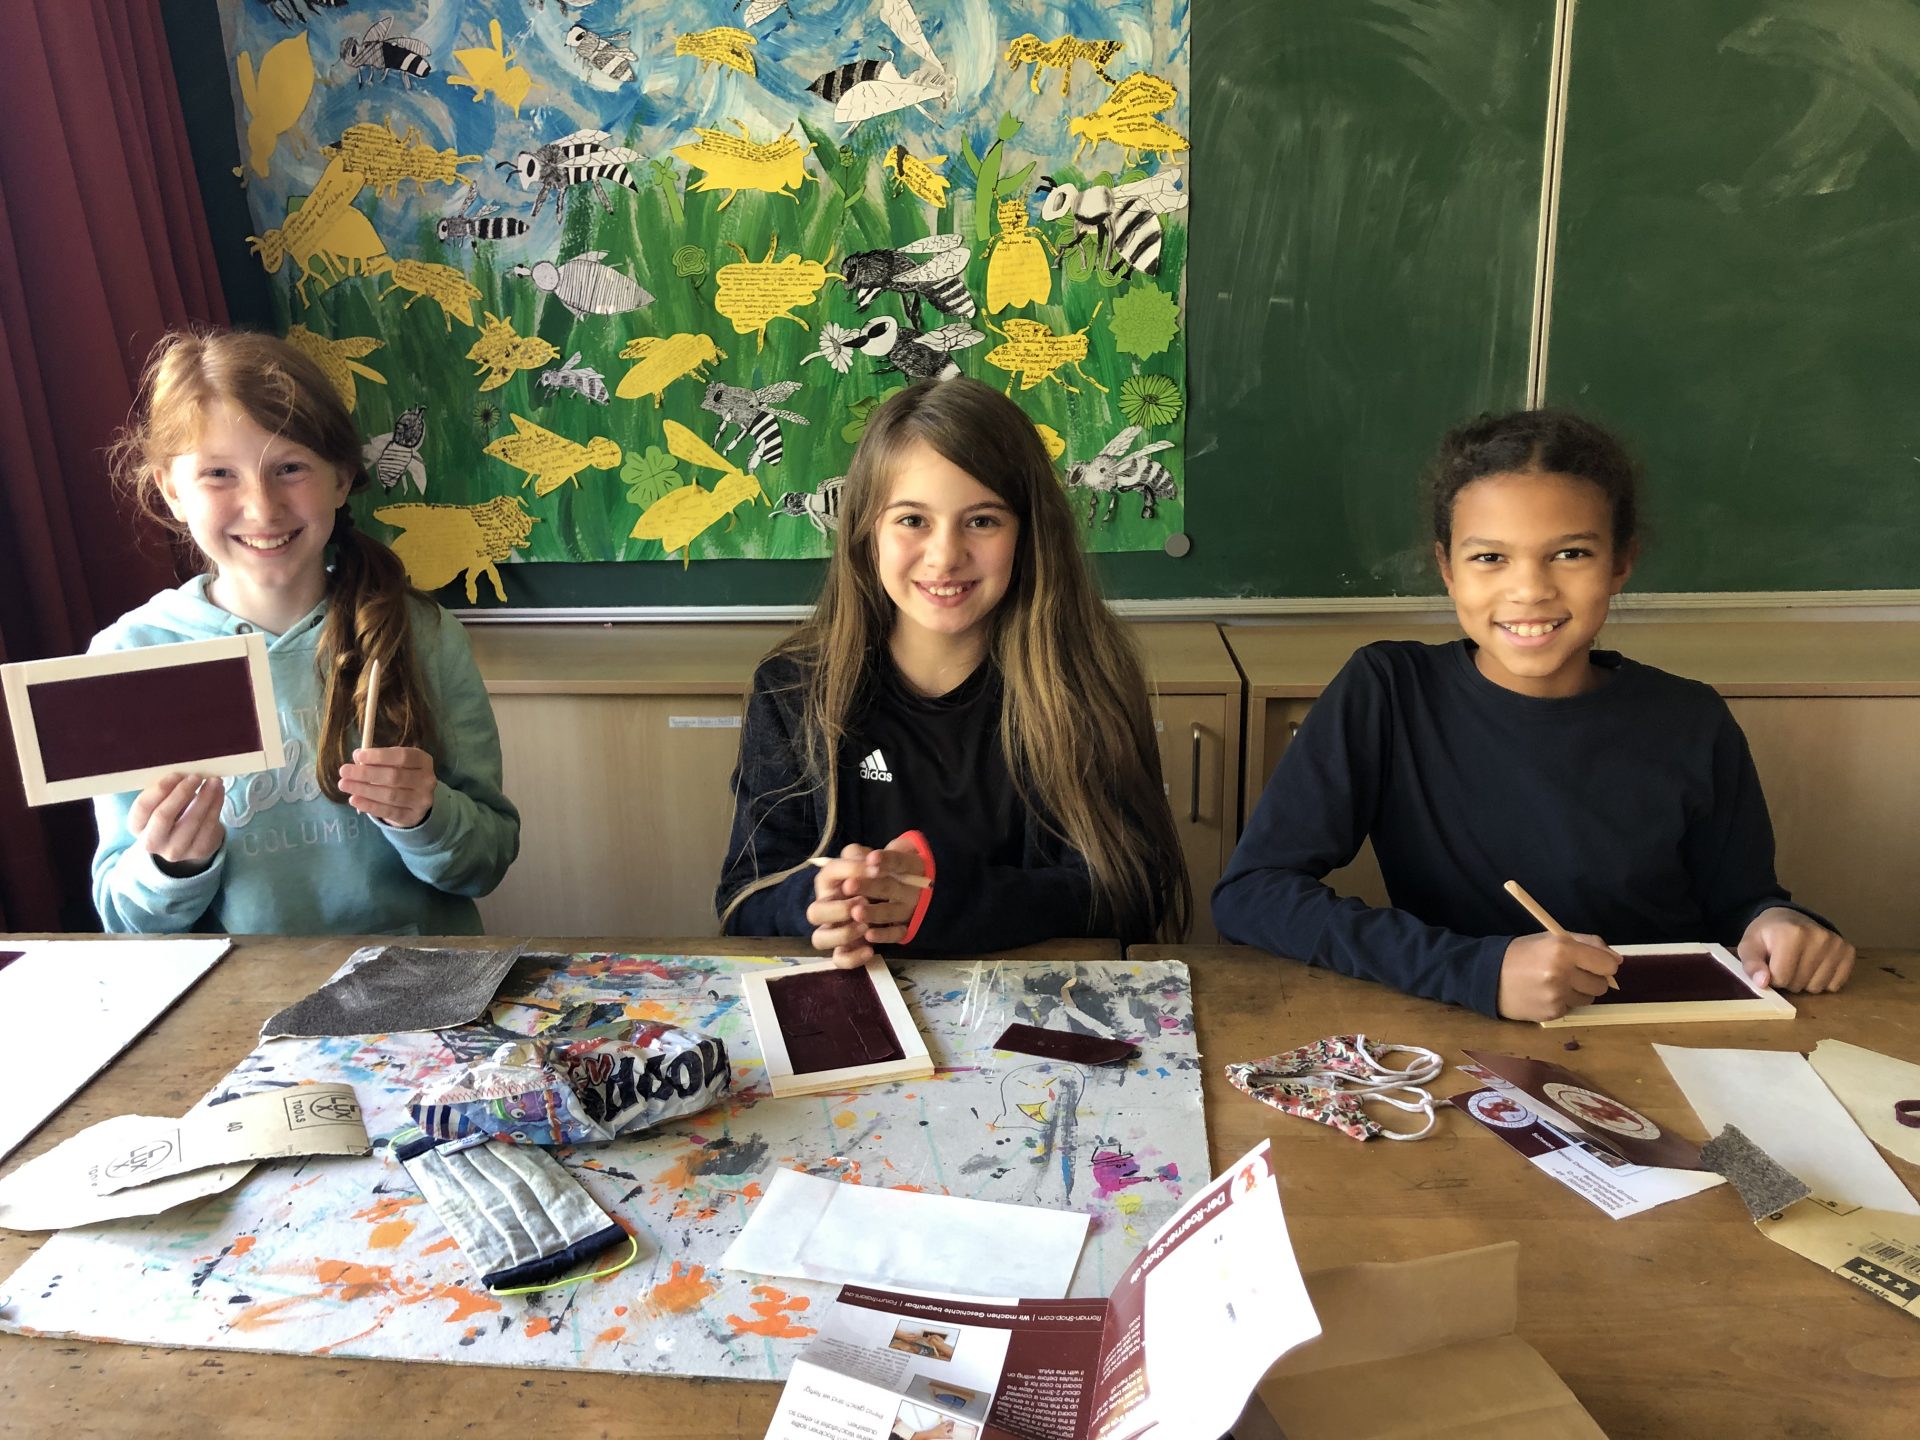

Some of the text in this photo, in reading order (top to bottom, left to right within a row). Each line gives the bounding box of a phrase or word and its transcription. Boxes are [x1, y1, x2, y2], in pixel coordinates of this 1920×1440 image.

[860, 767, 893, 782] adidas
[292, 1100, 306, 1122] TOOLS
[904, 1302, 943, 1313] begreifbar
[944, 1307, 985, 1318] Geschichte
[987, 1312, 1017, 1320] machen
